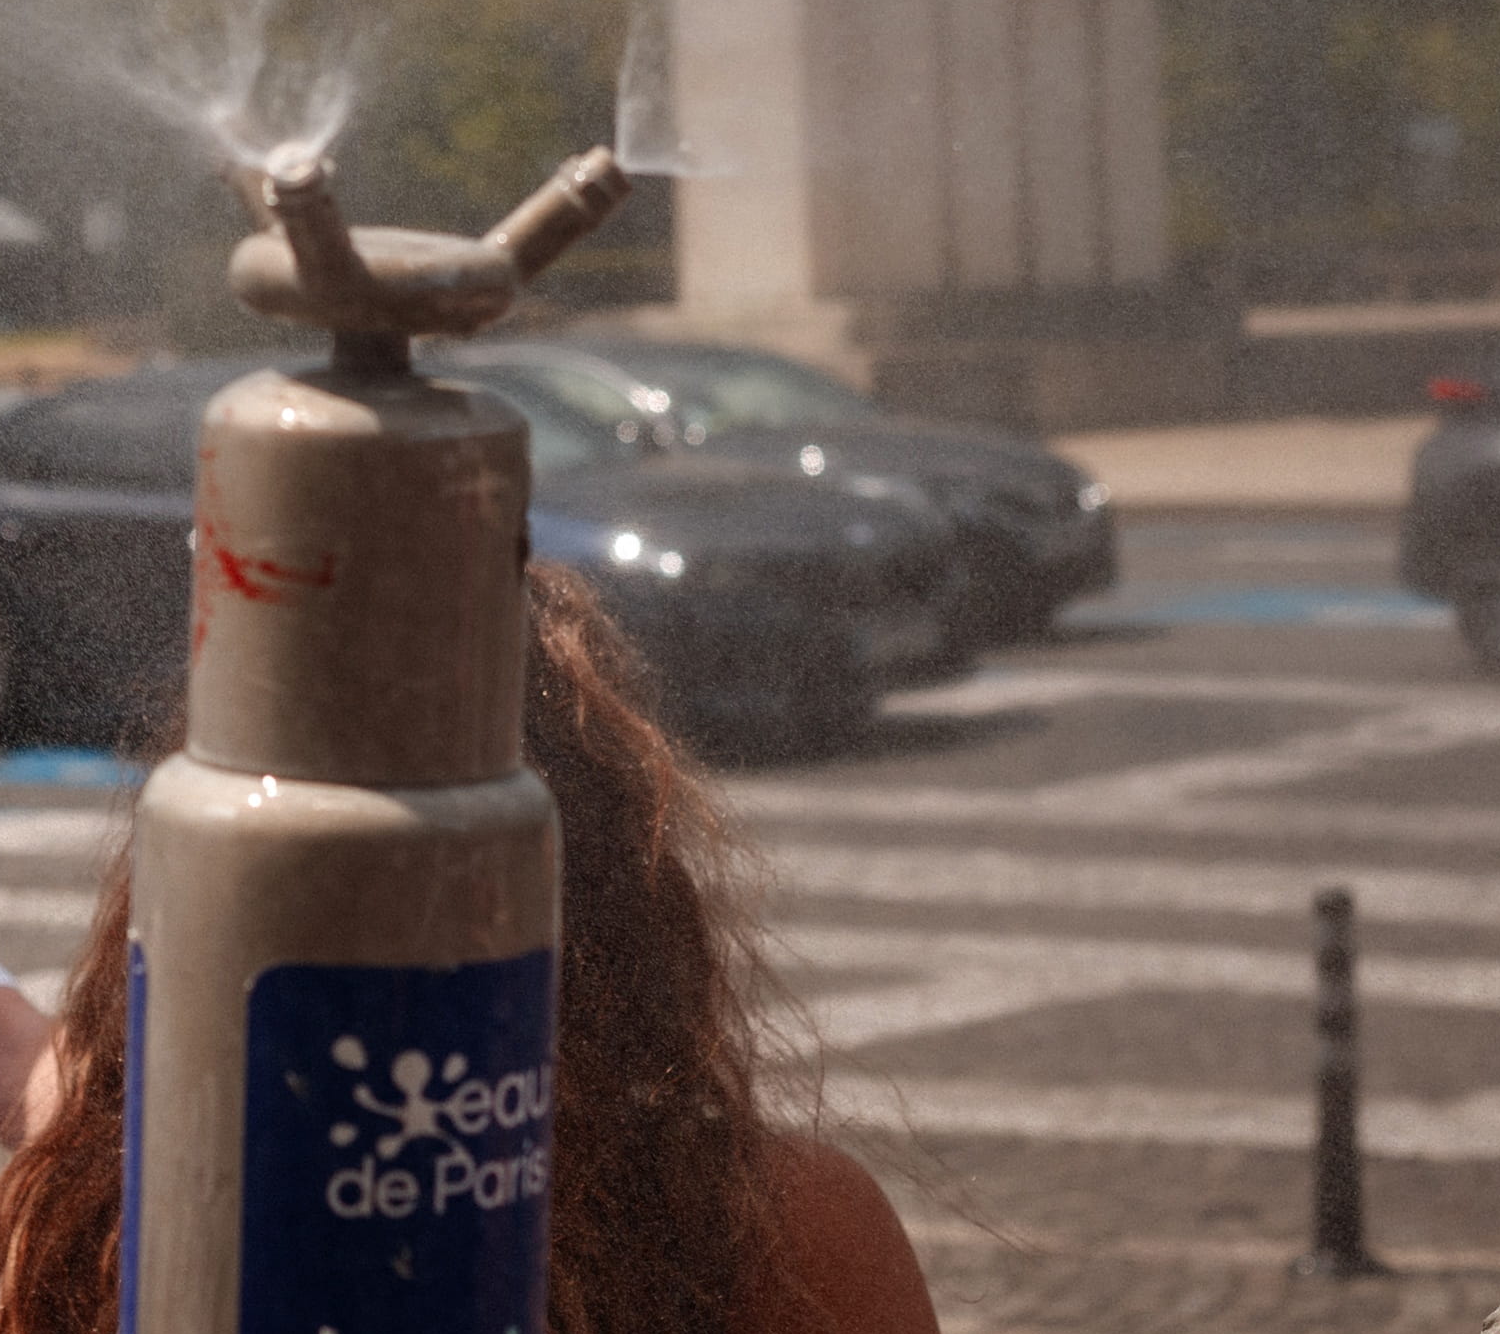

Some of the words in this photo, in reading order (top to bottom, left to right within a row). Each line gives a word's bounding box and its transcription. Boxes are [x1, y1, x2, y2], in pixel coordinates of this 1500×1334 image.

[450, 1063, 550, 1136] eau
[325, 1152, 420, 1220] de
[432, 1139, 548, 1216] Paris
